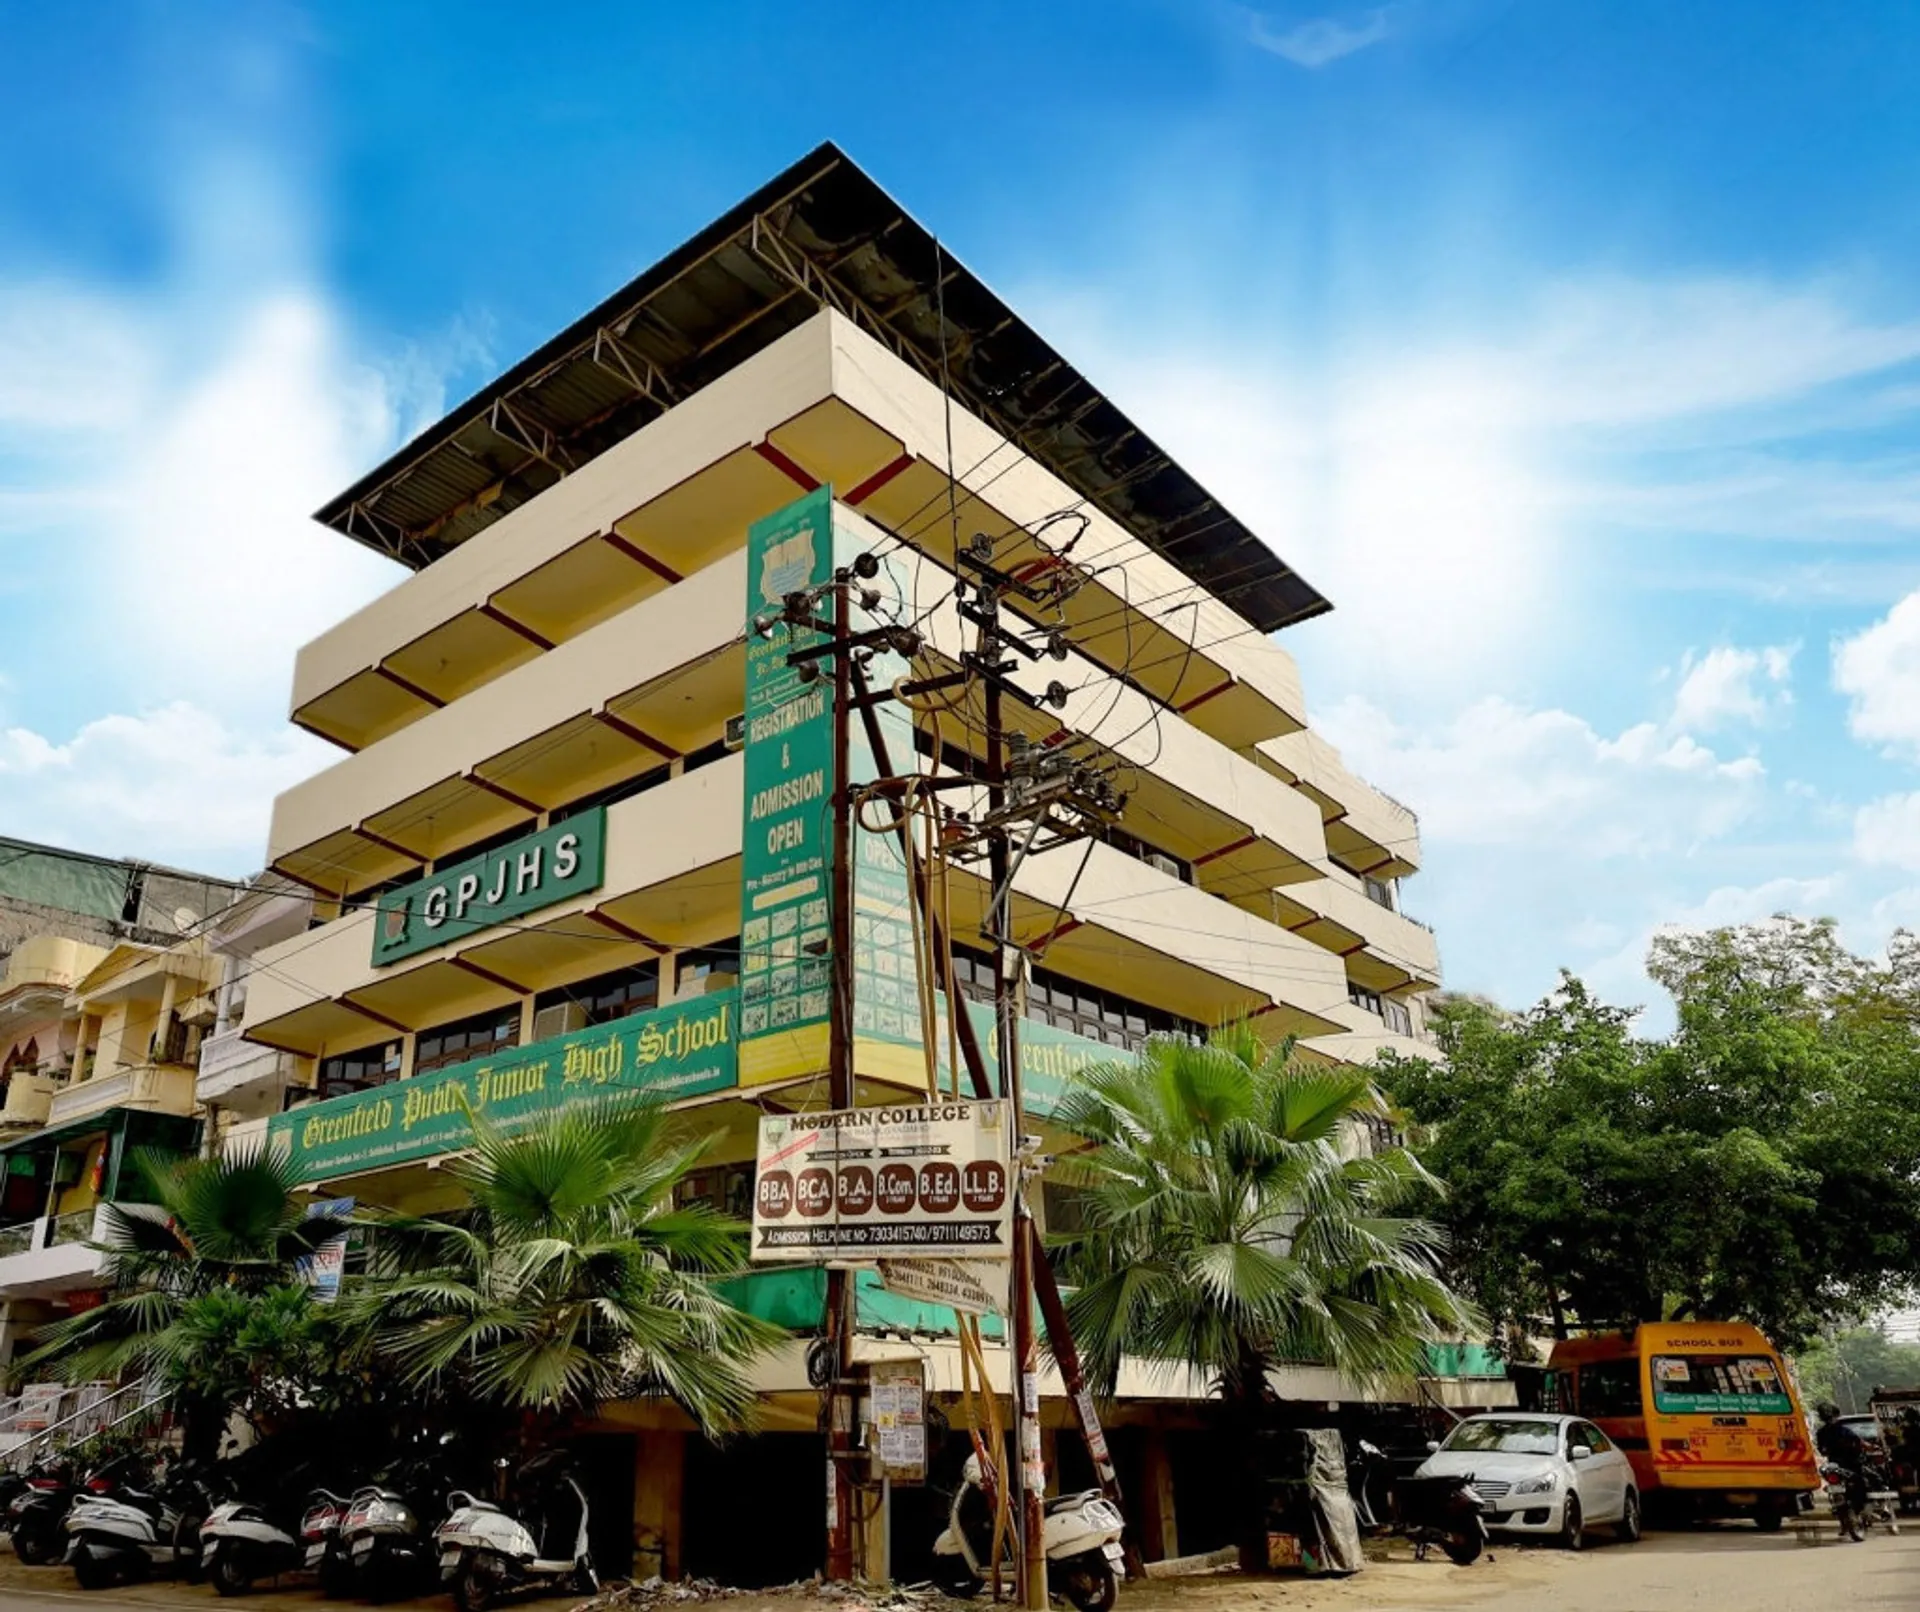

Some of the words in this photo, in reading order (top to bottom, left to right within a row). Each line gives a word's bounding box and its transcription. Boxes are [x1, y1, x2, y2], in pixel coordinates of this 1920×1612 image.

[750, 691, 824, 744] REGISTRATION
[781, 743, 791, 769] &
[750, 770, 823, 821] ADMISSION
[767, 818, 803, 856] OPEN
[424, 833, 578, 927] GPJHS
[303, 1097, 393, 1150] Greenfield
[474, 1060, 549, 1113] Junior
[561, 1035, 623, 1090] High
[636, 1006, 729, 1068] School
[790, 1111, 872, 1131] MODERN
[878, 1105, 970, 1125] COLLEGE
[760, 1180, 789, 1201] BBA
[798, 1178, 830, 1200] BCA
[838, 1175, 872, 1197] B.A.
[878, 1173, 913, 1195] B.Com.
[920, 1172, 957, 1195] B.Ed.
[963, 1171, 1004, 1194] LL.B.
[767, 1230, 810, 1245] ADMISSION
[1667, 1339, 1715, 1348] SCHOOL
[1718, 1338, 1744, 1347] BUS
